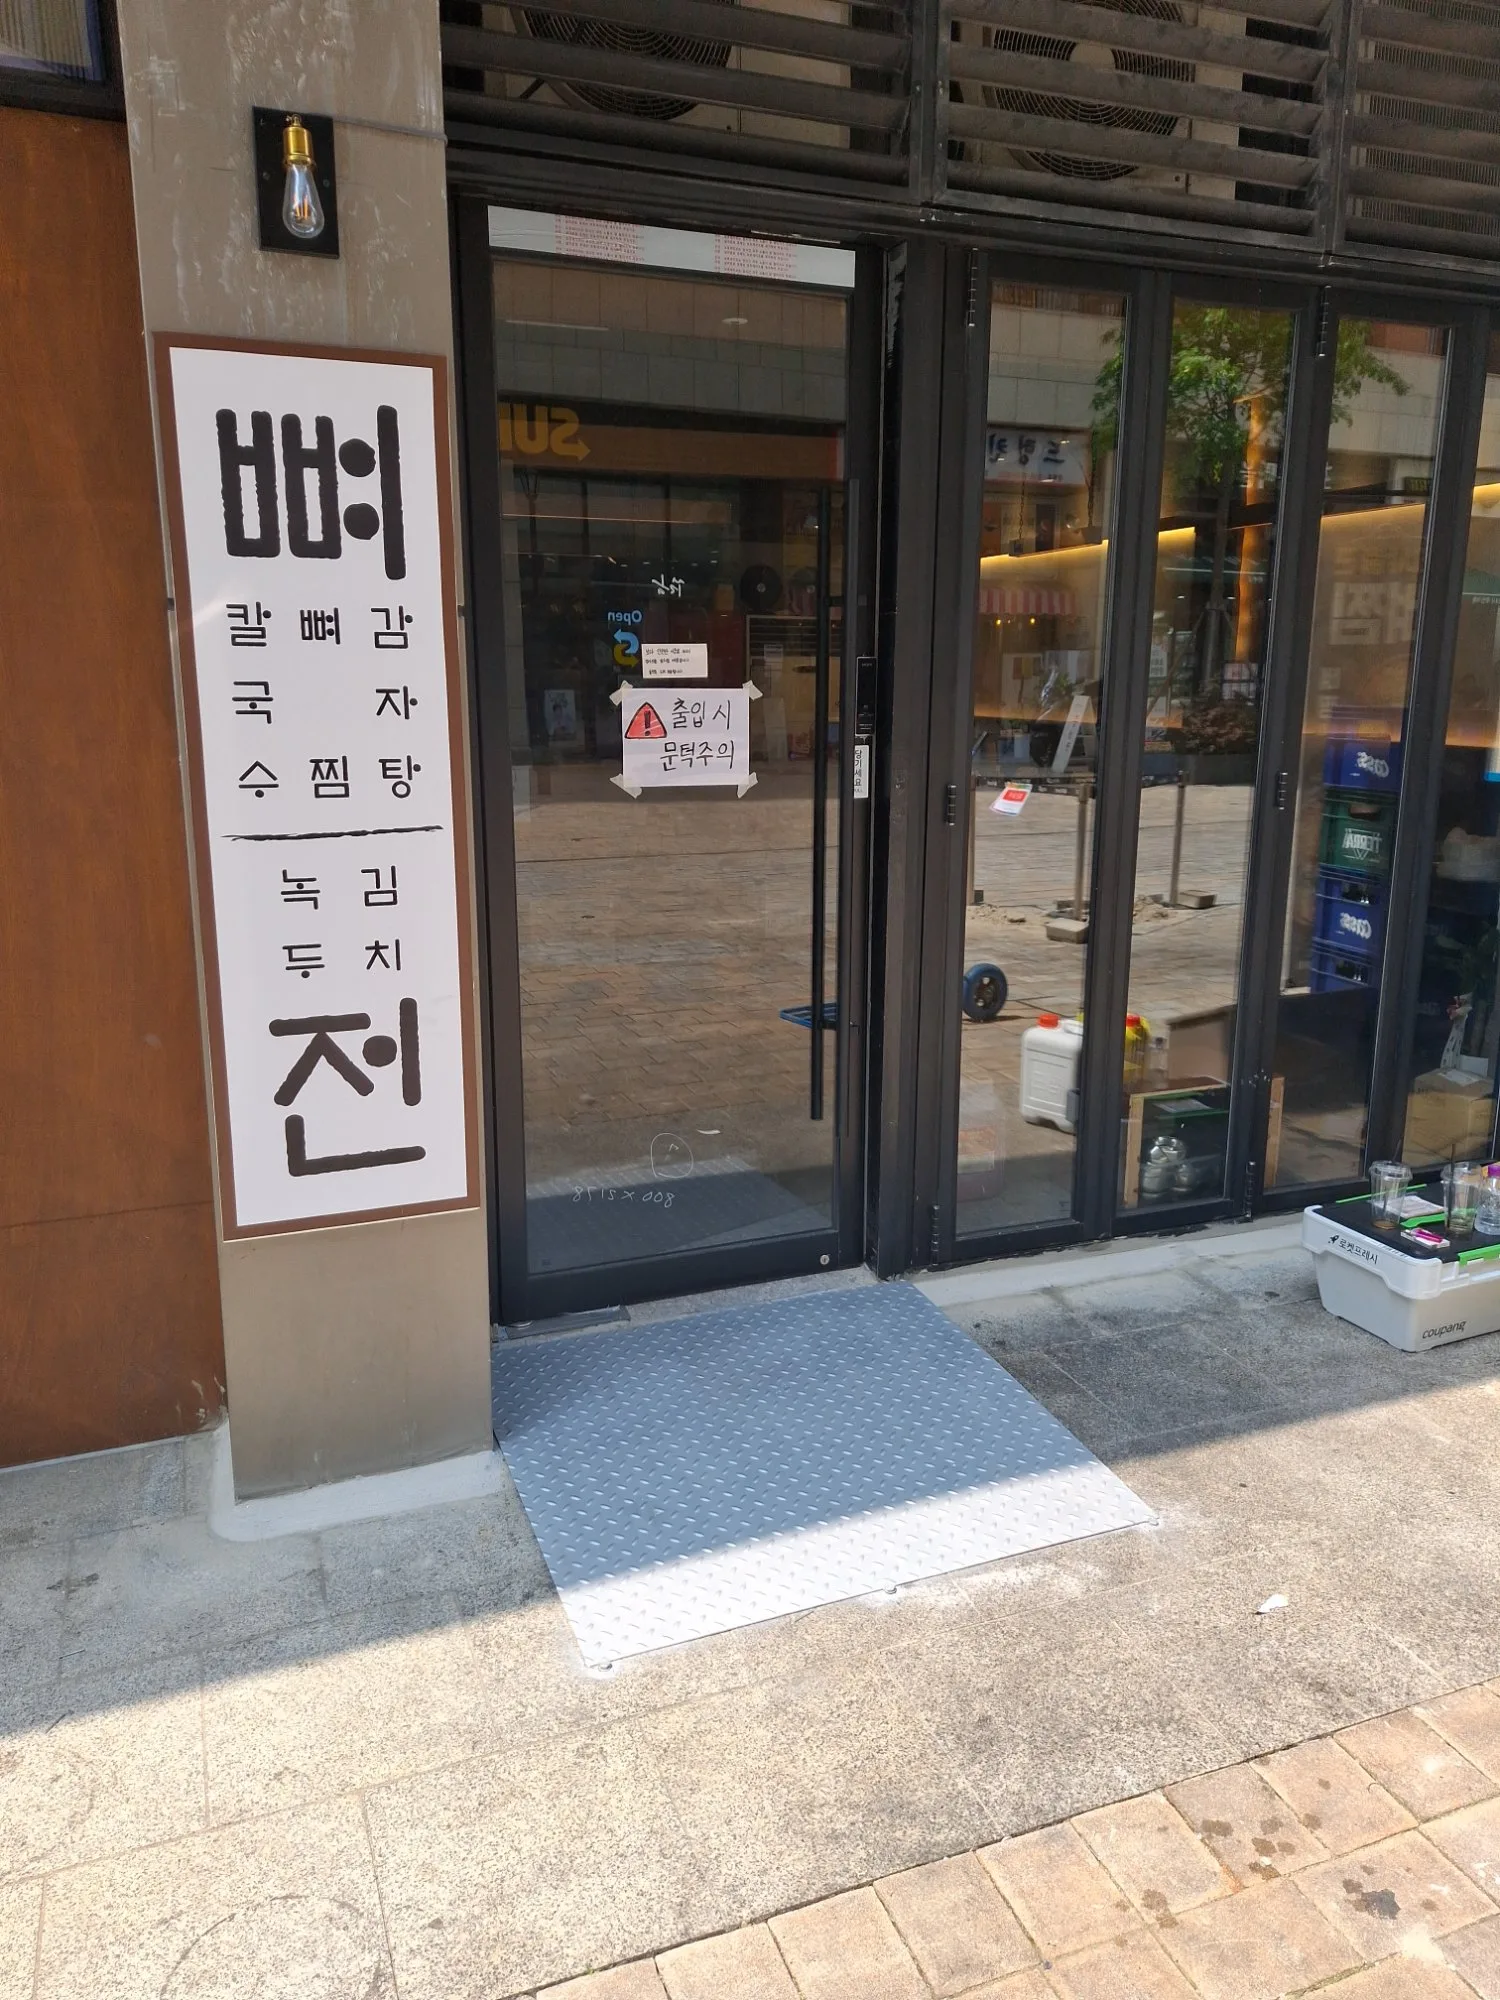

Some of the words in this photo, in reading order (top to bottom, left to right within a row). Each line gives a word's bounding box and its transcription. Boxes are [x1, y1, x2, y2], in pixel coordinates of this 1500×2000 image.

[216, 405, 406, 580] 뼈
[671, 698, 706, 729] 출입
[712, 699, 732, 730] 시
[660, 740, 735, 771] 문턱주의
[854, 749, 862, 786] 당기세요
[269, 998, 426, 1177] 전
[1338, 1238, 1378, 1265] 로켓프레시
[1422, 1320, 1467, 1340] coupang
